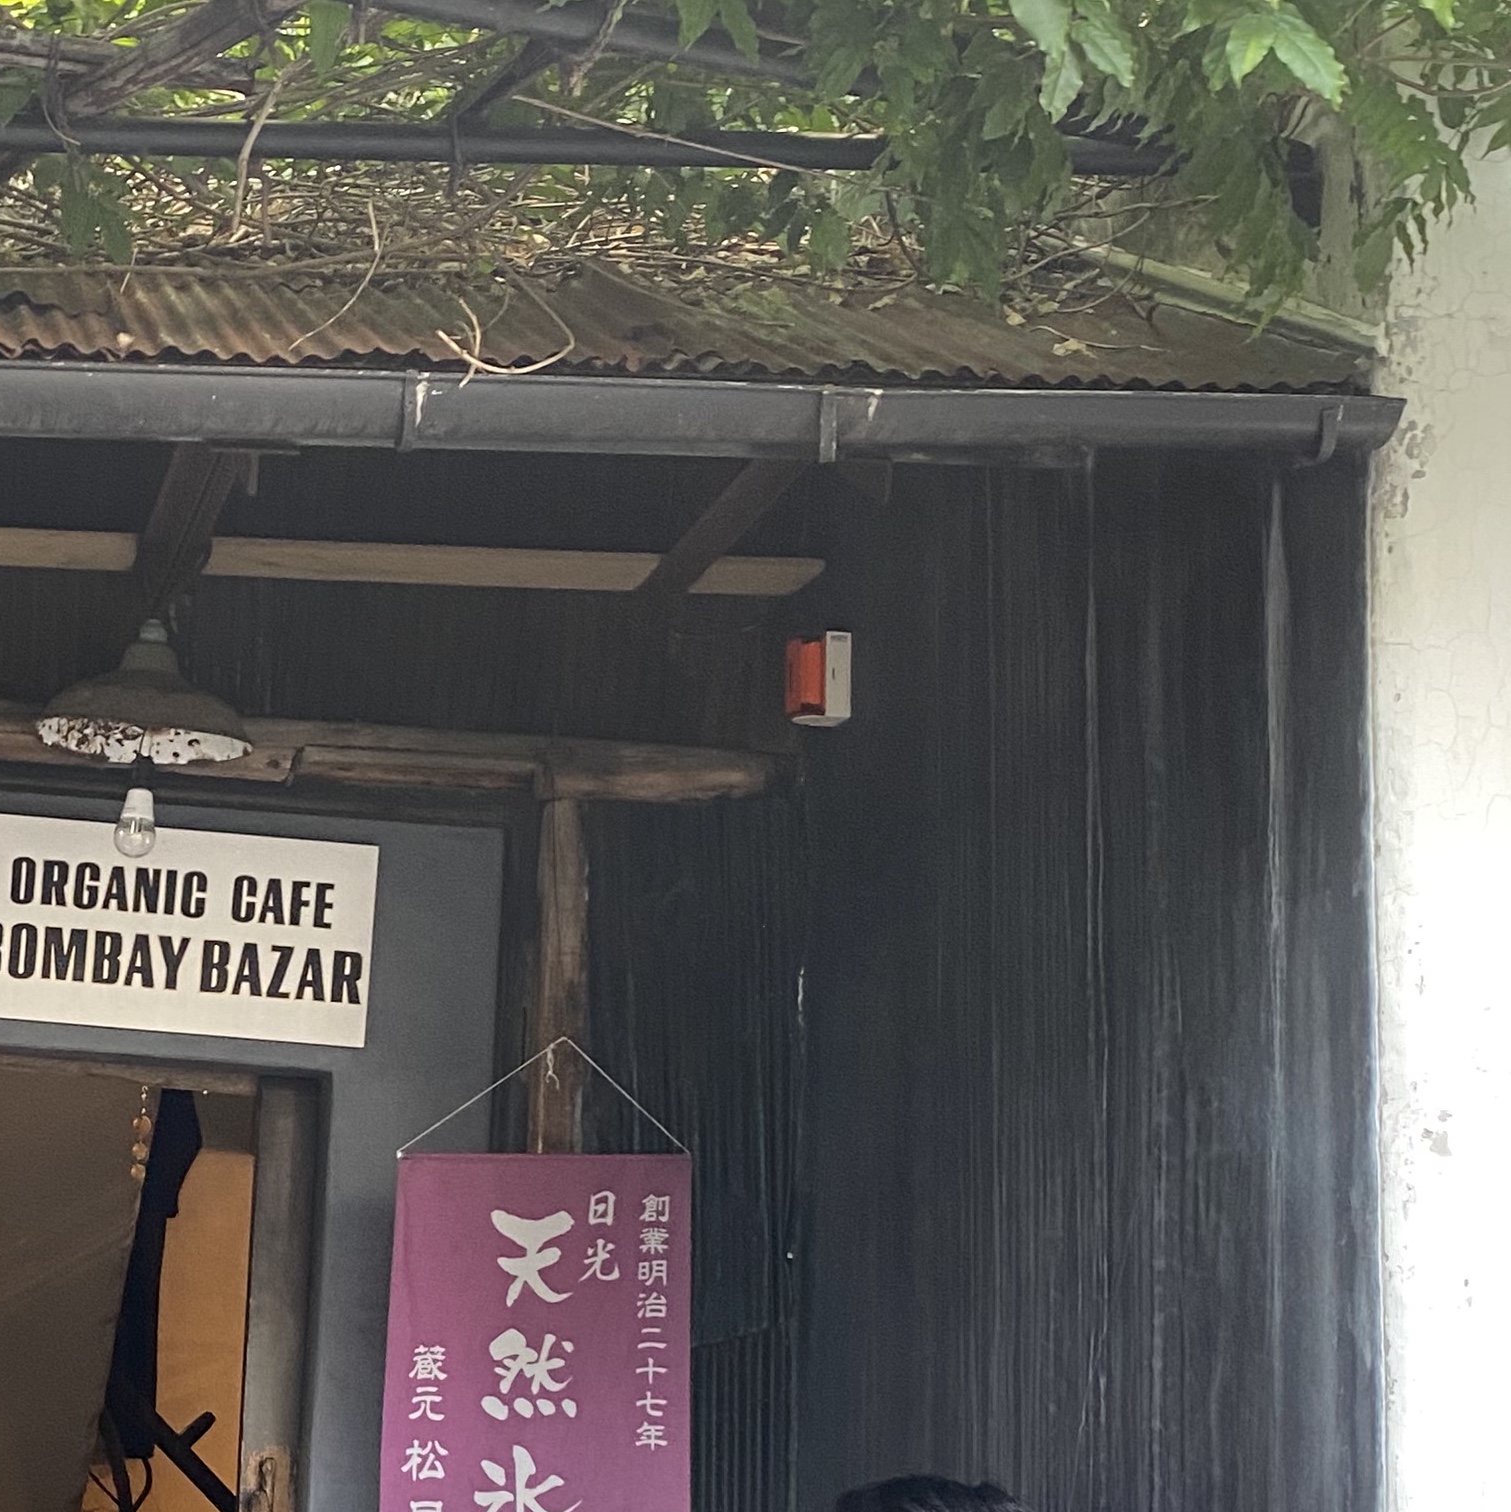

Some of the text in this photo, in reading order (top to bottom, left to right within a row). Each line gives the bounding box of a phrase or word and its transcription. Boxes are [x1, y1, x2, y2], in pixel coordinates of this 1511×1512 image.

[10, 856, 335, 929] ORGANIC CAFE
[199, 940, 363, 1005] BAZAR
[578, 1190, 620, 1282] 日光
[635, 1194, 671, 1452] 創業明治二十七年
